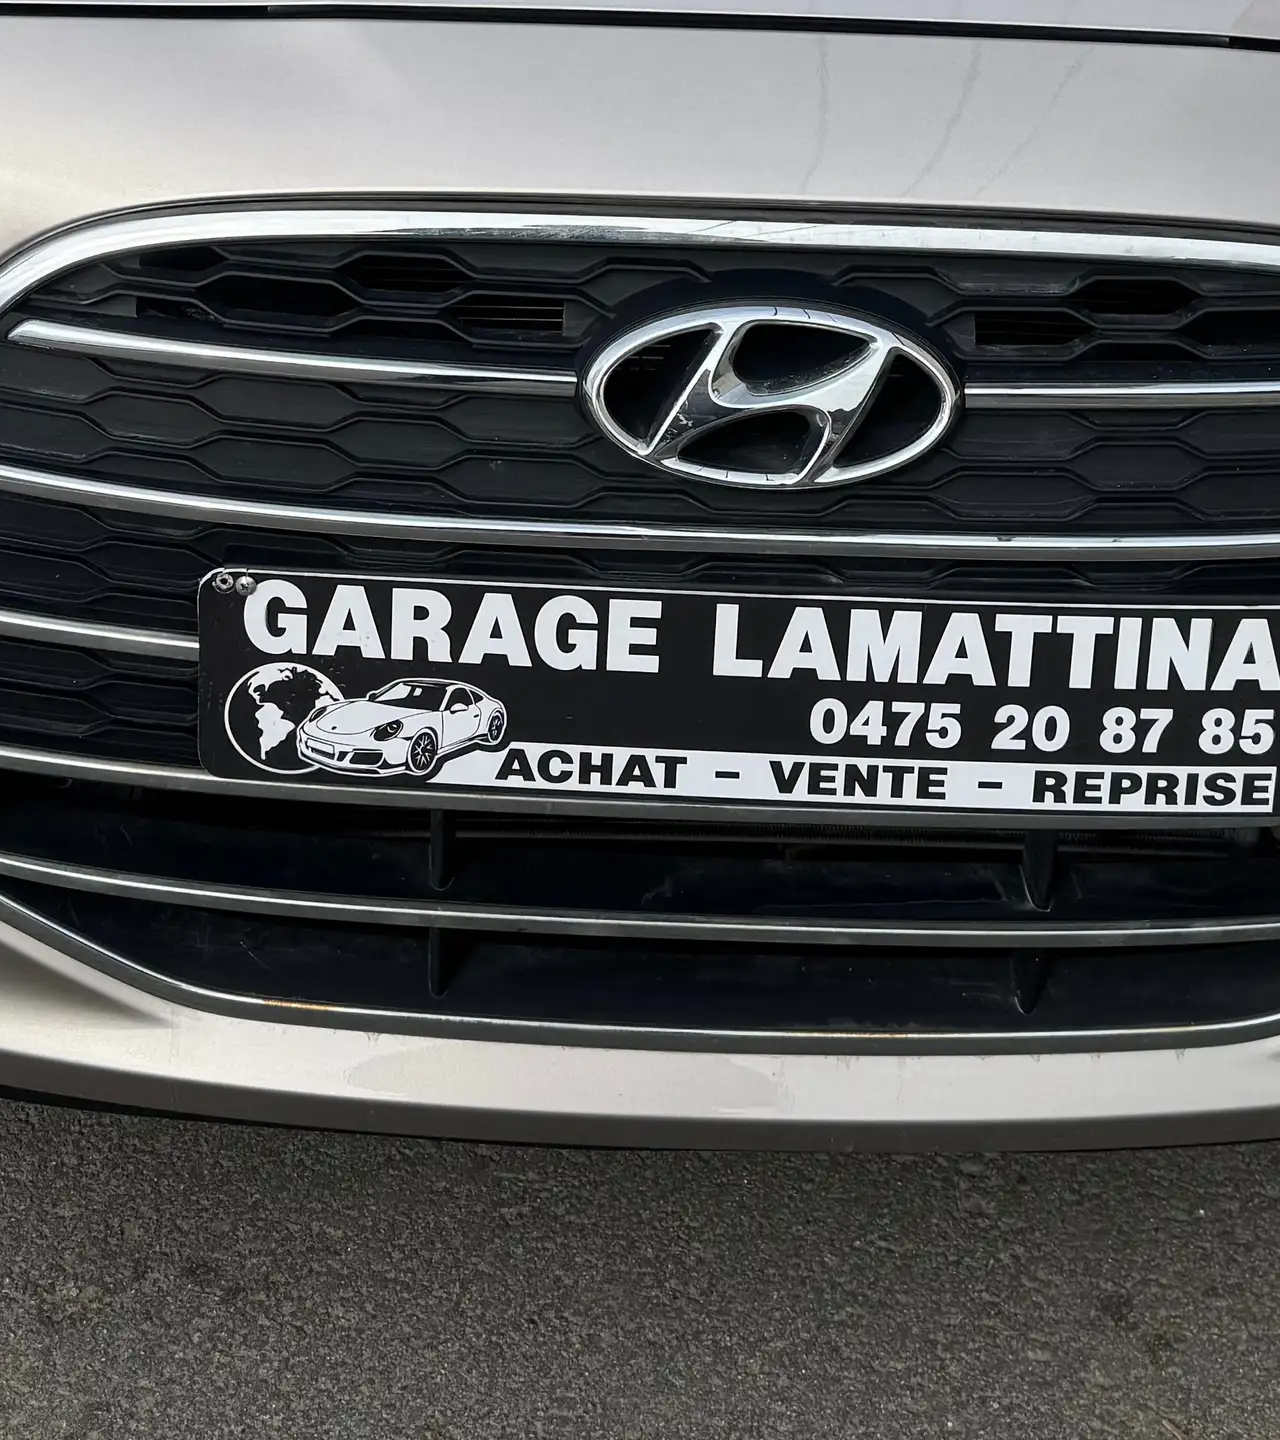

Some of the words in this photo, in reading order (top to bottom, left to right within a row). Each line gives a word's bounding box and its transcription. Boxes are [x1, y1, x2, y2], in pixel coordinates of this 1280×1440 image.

[244, 580, 662, 672] GARAGE
[810, 698, 961, 748] 0475
[991, 705, 1069, 751] 20
[1100, 707, 1173, 753] 87
[1199, 708, 1274, 754] 85
[495, 749, 687, 788] ACHAT
[769, 761, 947, 799] VENTE
[1033, 771, 1273, 806] REPRISE
